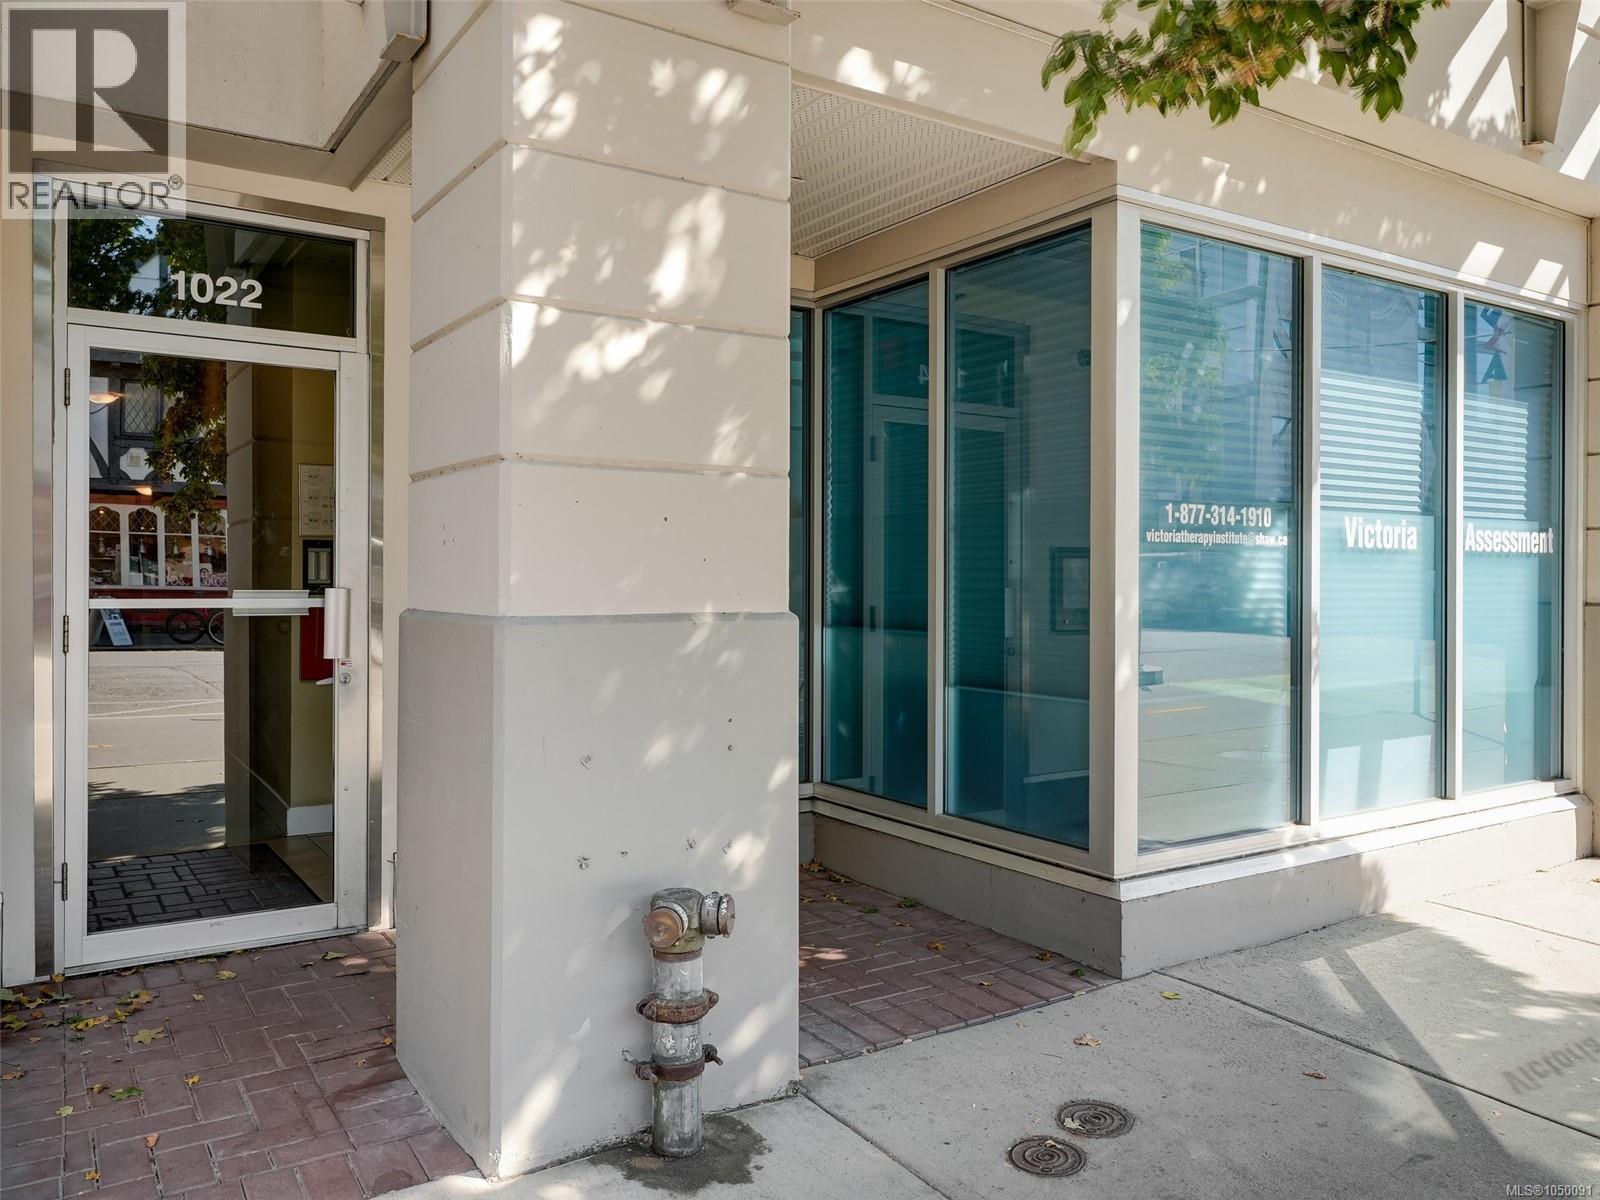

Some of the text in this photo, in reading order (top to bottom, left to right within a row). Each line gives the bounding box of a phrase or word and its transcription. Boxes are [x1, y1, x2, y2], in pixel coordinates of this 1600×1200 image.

[170, 270, 263, 309] 1022
[1166, 502, 1272, 528] 1-877-314-1910
[1146, 529, 1288, 547] victoriatherapyinstitute@shaw.ca
[1344, 516, 1554, 554] Victoria Assessment
